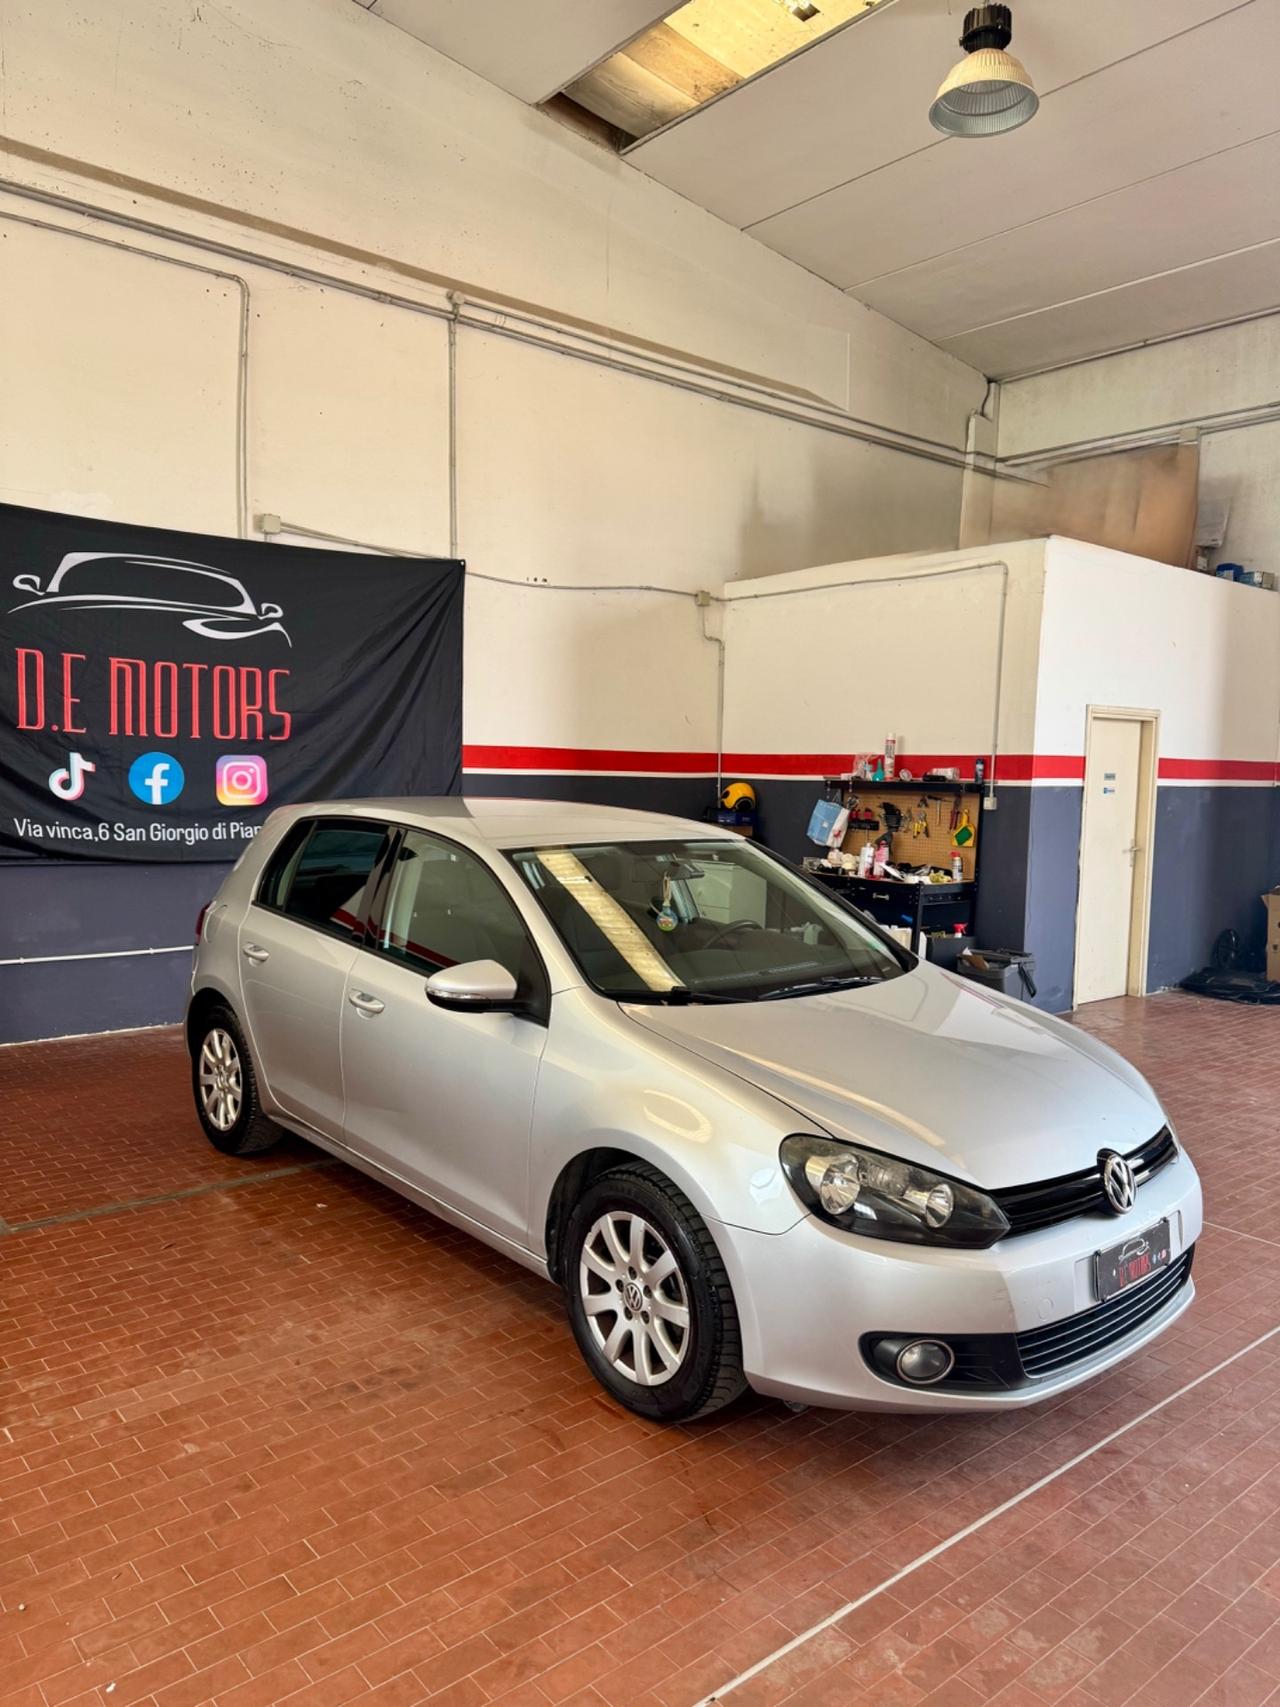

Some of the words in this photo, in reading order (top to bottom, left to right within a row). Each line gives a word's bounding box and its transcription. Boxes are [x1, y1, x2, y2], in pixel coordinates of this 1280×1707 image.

[15, 648, 87, 734] D.E
[108, 656, 292, 741] MOTORS
[13, 818, 43, 838] Via
[45, 821, 109, 842] vinca,6
[113, 823, 146, 841] San
[150, 822, 209, 846] Giorgio
[212, 822, 227, 840] di
